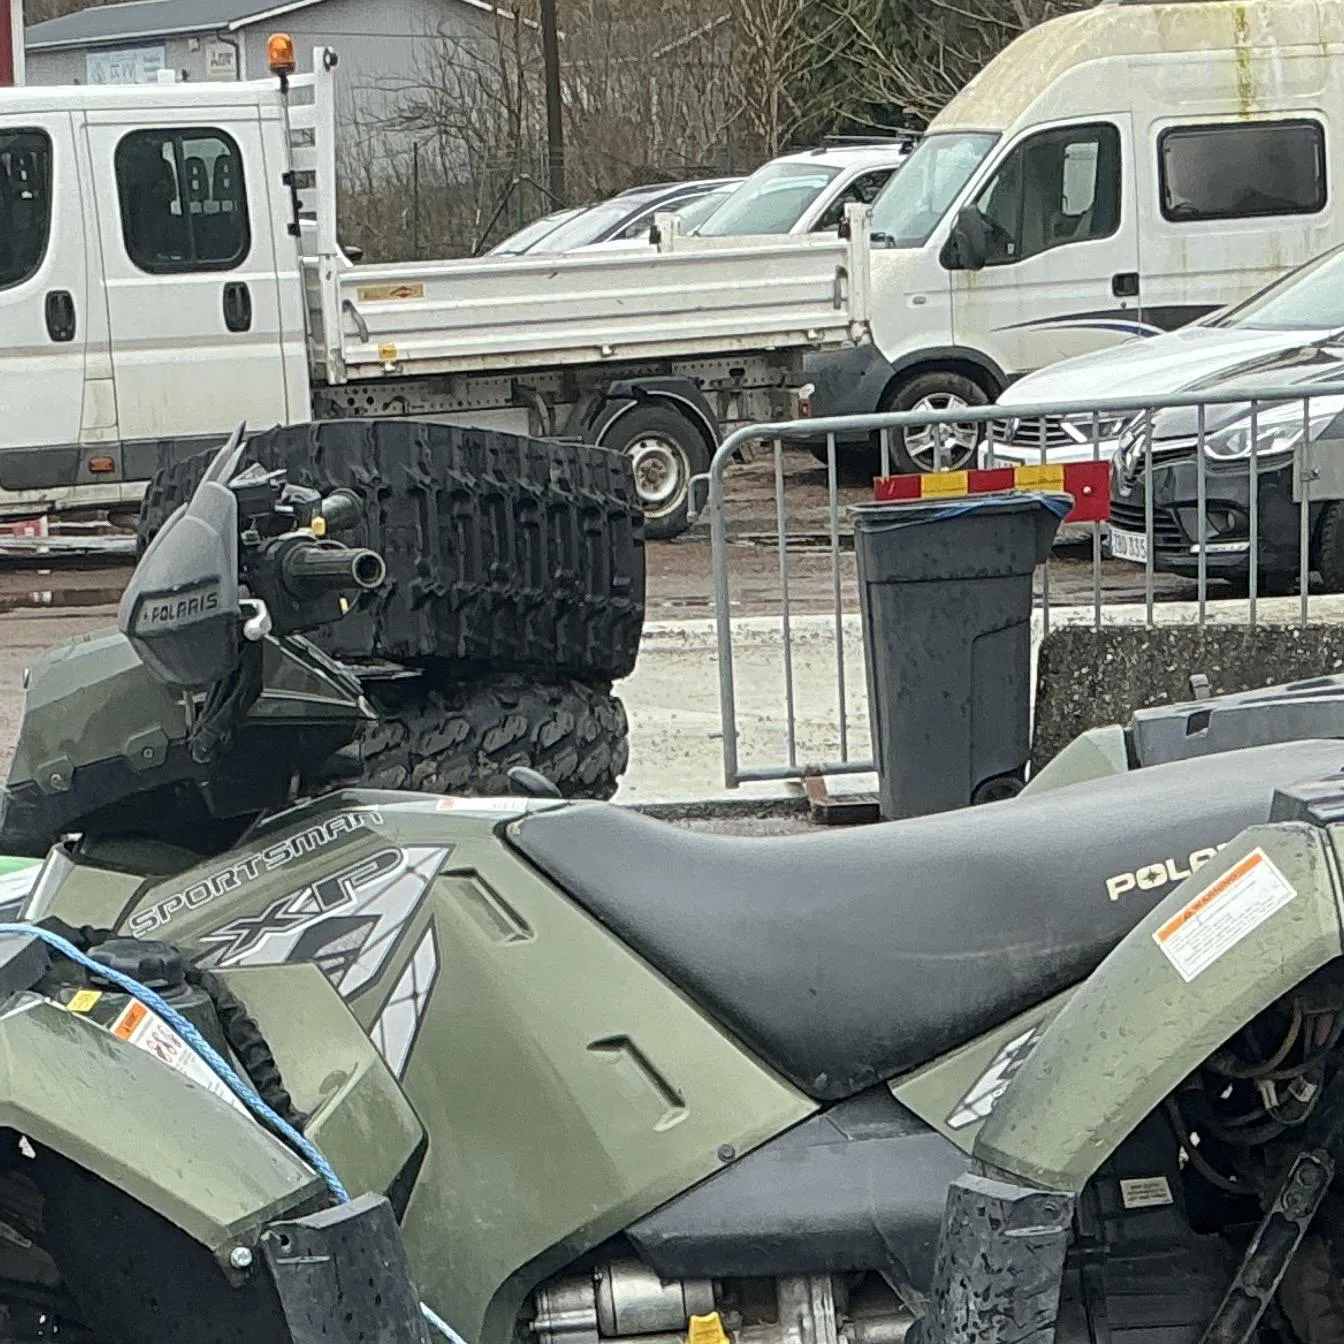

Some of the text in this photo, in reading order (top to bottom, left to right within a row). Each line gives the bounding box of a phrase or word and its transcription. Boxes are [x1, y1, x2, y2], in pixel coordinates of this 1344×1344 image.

[151, 592, 219, 622] POLARIS
[129, 809, 386, 940] SPORTSMAN
[1106, 842, 1227, 901] POLA
